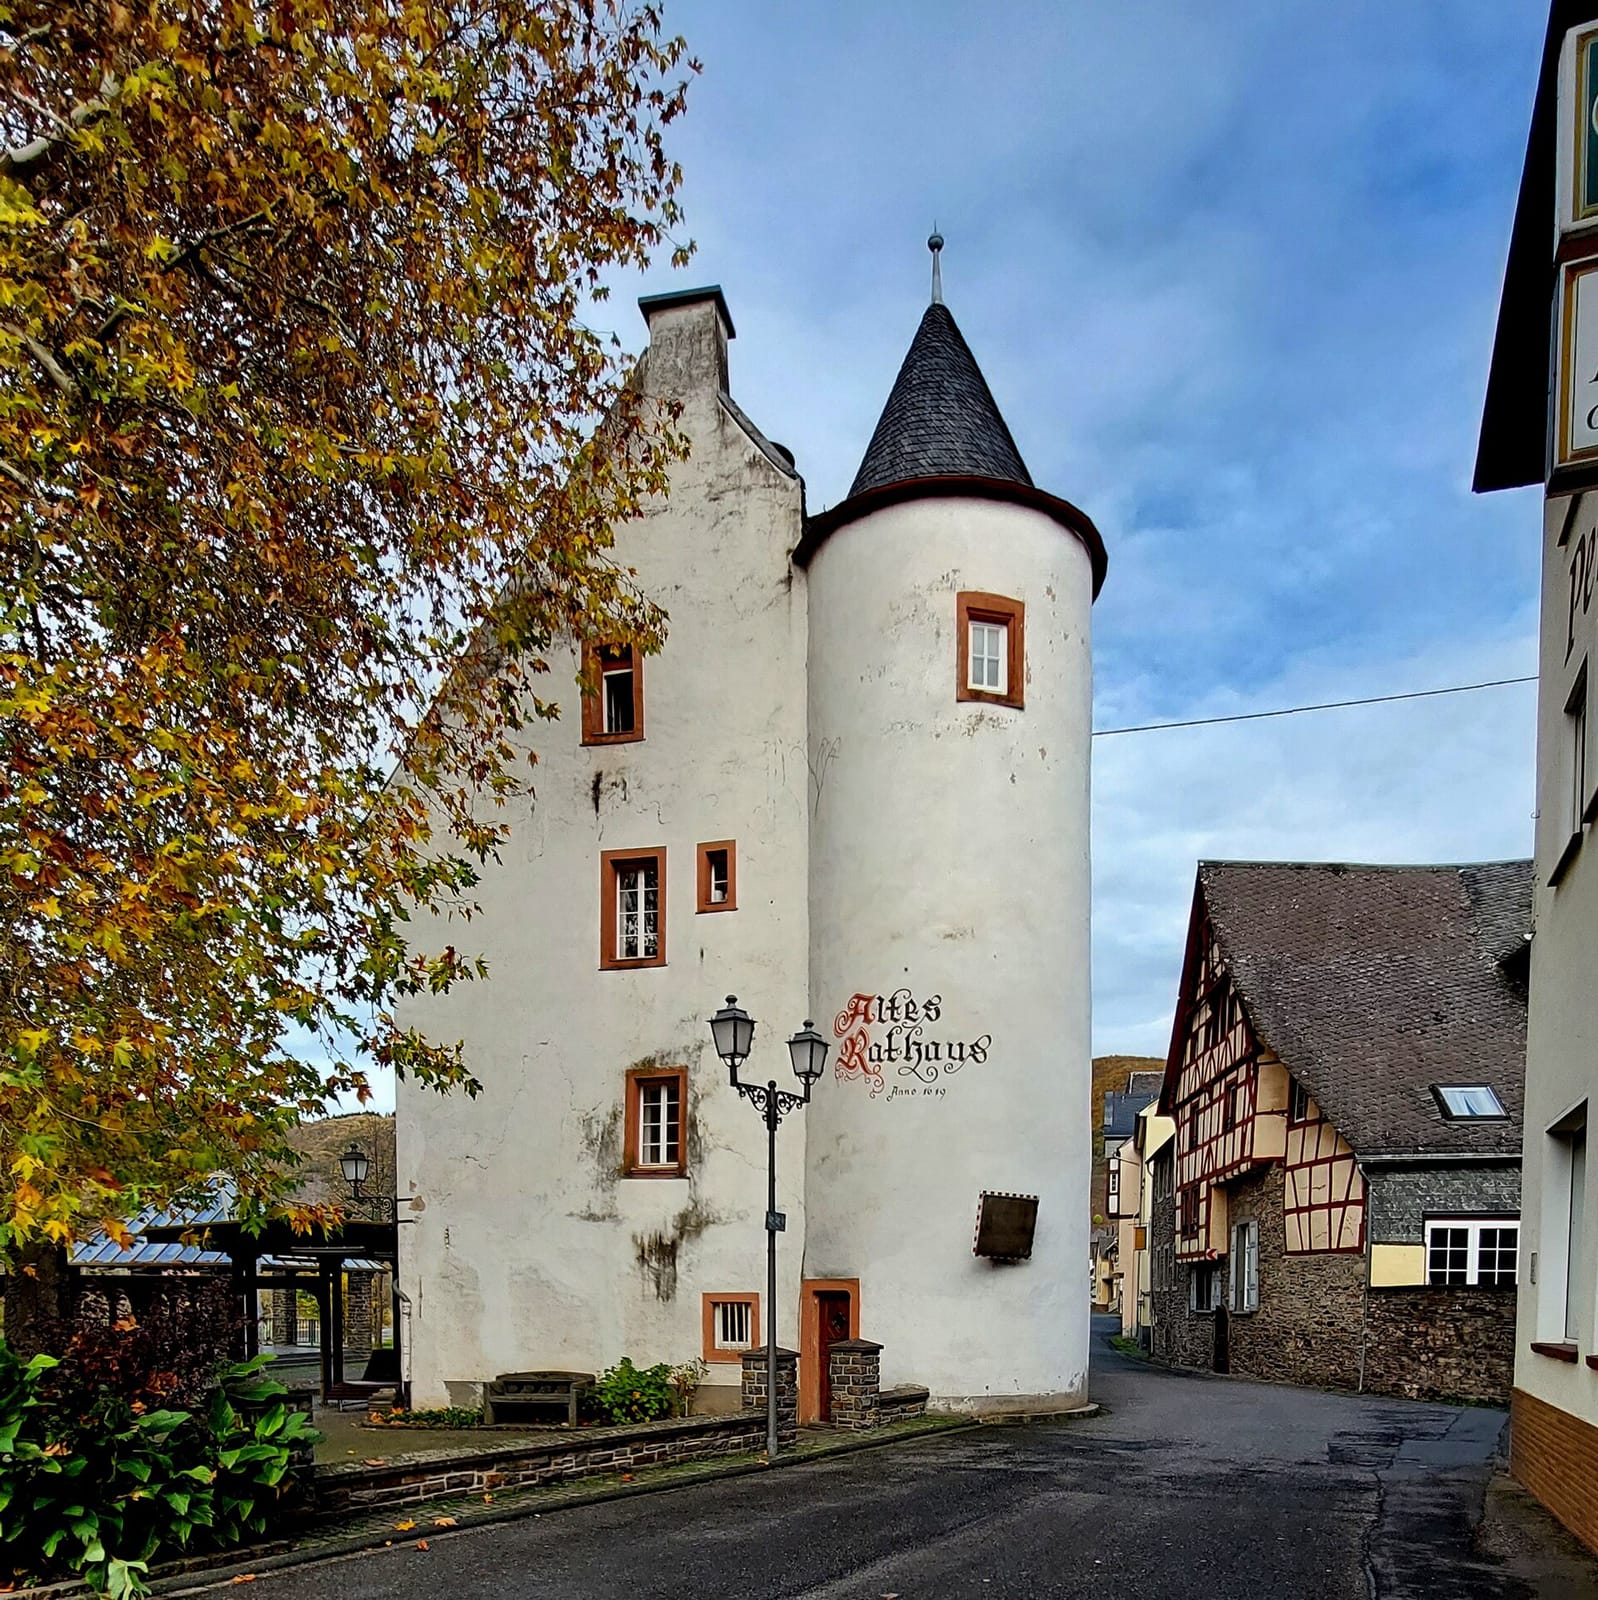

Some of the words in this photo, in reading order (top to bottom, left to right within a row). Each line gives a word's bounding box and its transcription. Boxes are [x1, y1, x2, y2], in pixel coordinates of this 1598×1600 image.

[1564, 525, 1598, 669] pe
[833, 988, 942, 1037] Altes
[834, 1026, 992, 1098] Rathaus
[886, 1085, 917, 1102] Anno
